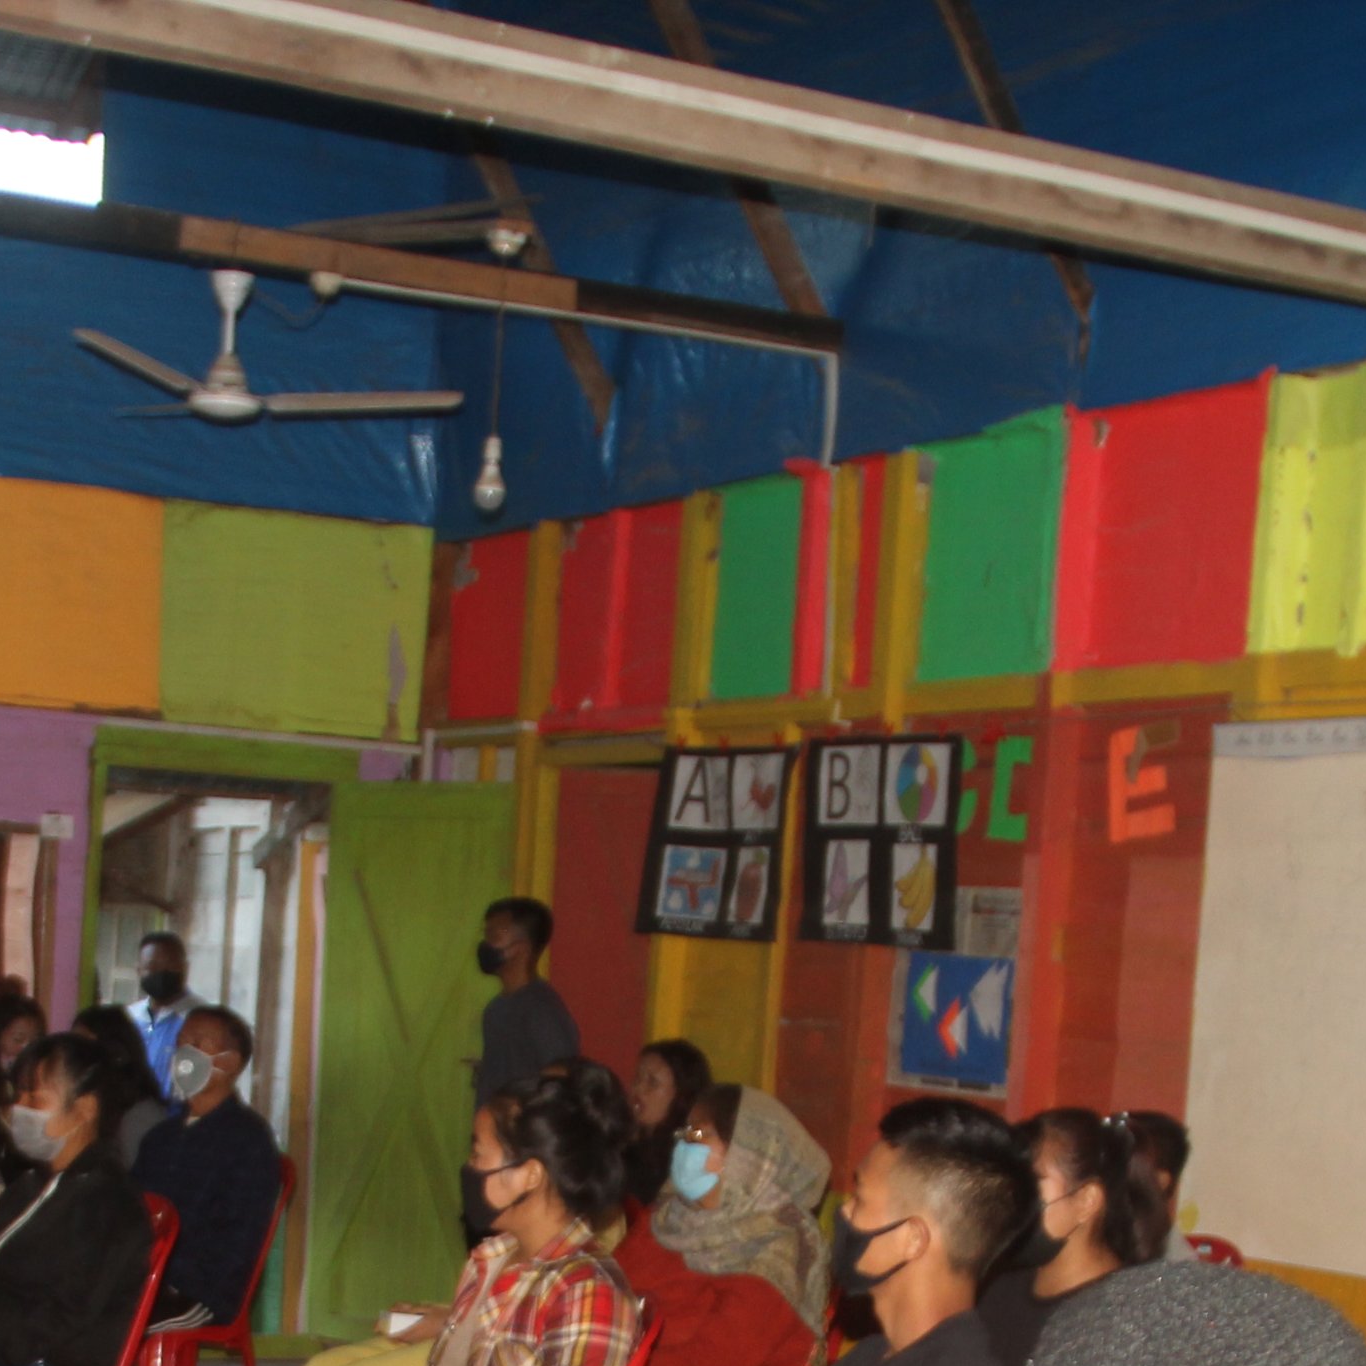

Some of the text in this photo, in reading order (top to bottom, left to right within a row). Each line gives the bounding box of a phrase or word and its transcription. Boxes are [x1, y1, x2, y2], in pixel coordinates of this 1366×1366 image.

[675, 756, 711, 823] A
[826, 750, 851, 821] B
[1107, 725, 1177, 844] E
